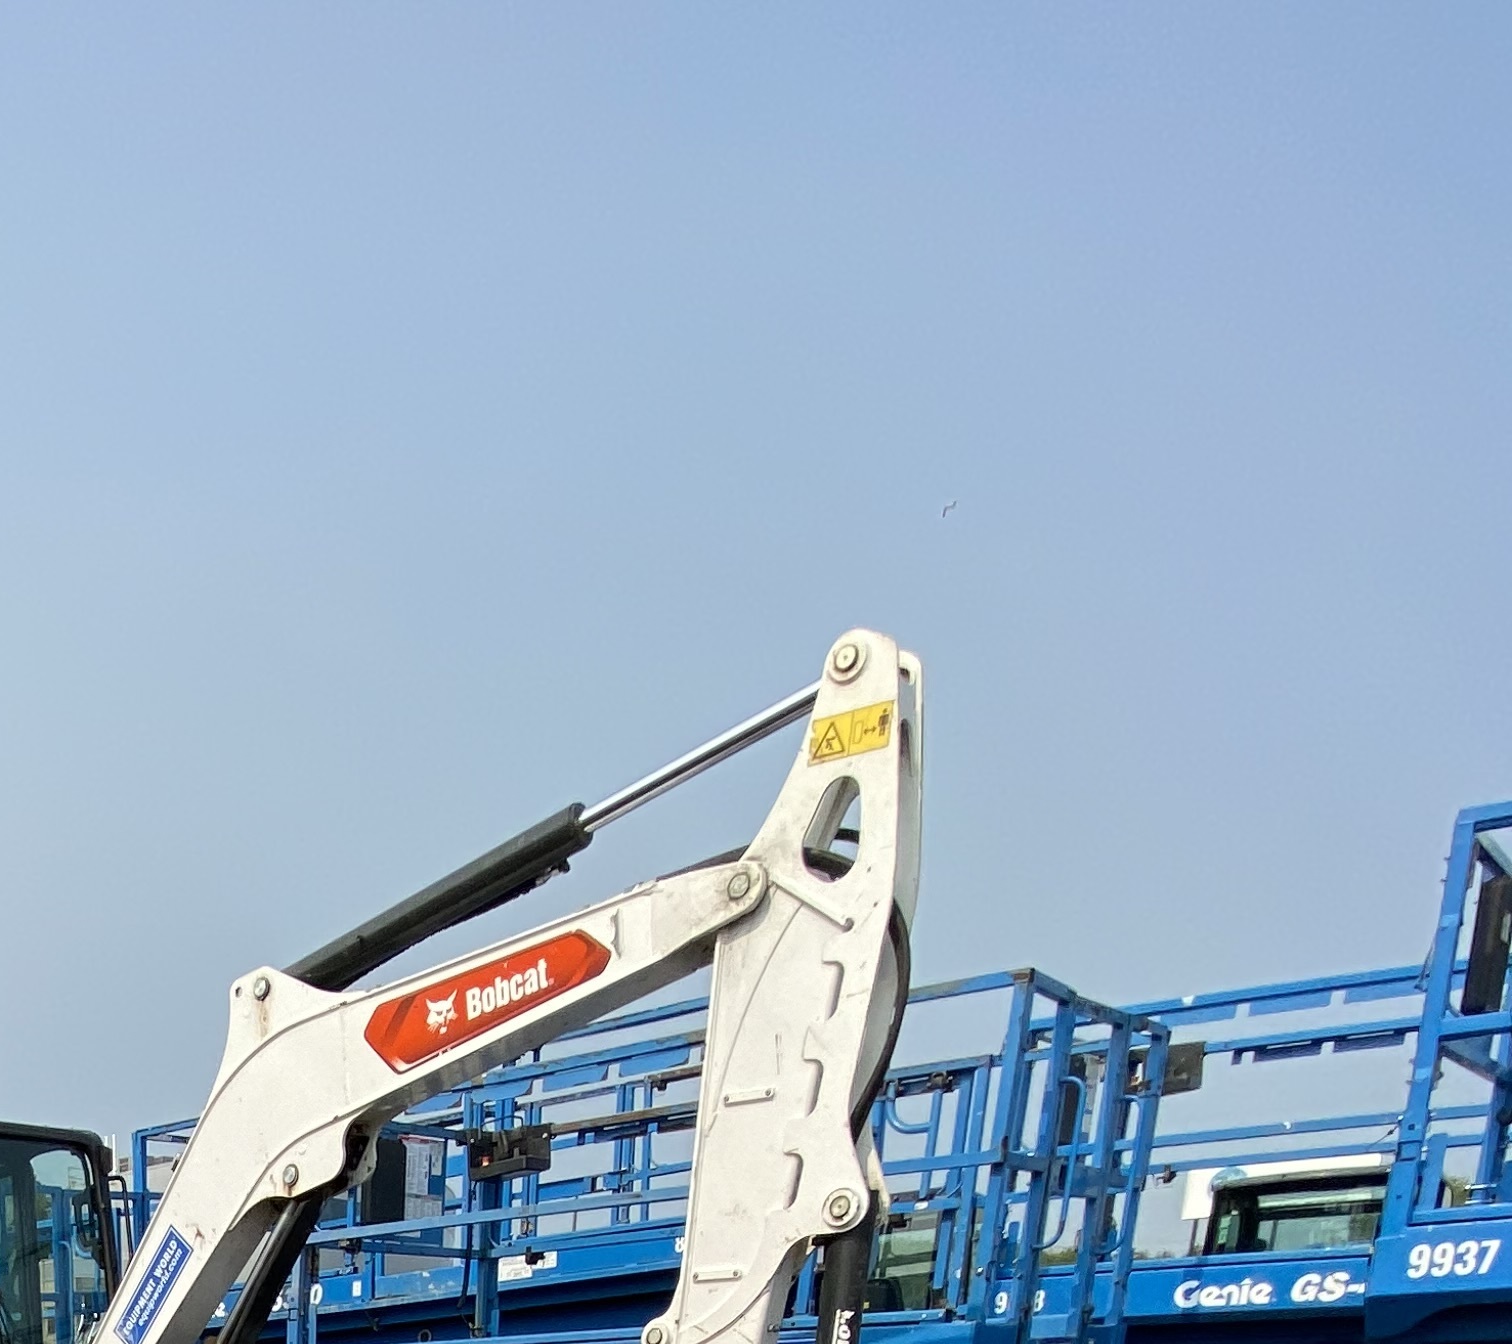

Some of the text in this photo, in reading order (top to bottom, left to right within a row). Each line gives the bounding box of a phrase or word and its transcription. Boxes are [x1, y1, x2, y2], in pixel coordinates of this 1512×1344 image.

[465, 958, 549, 1021] Bobcat
[1407, 1239, 1501, 1280] 9937
[123, 1240, 178, 1336] EQUIPMENT WORLD
[1173, 1271, 1366, 1309] Genie GS-
